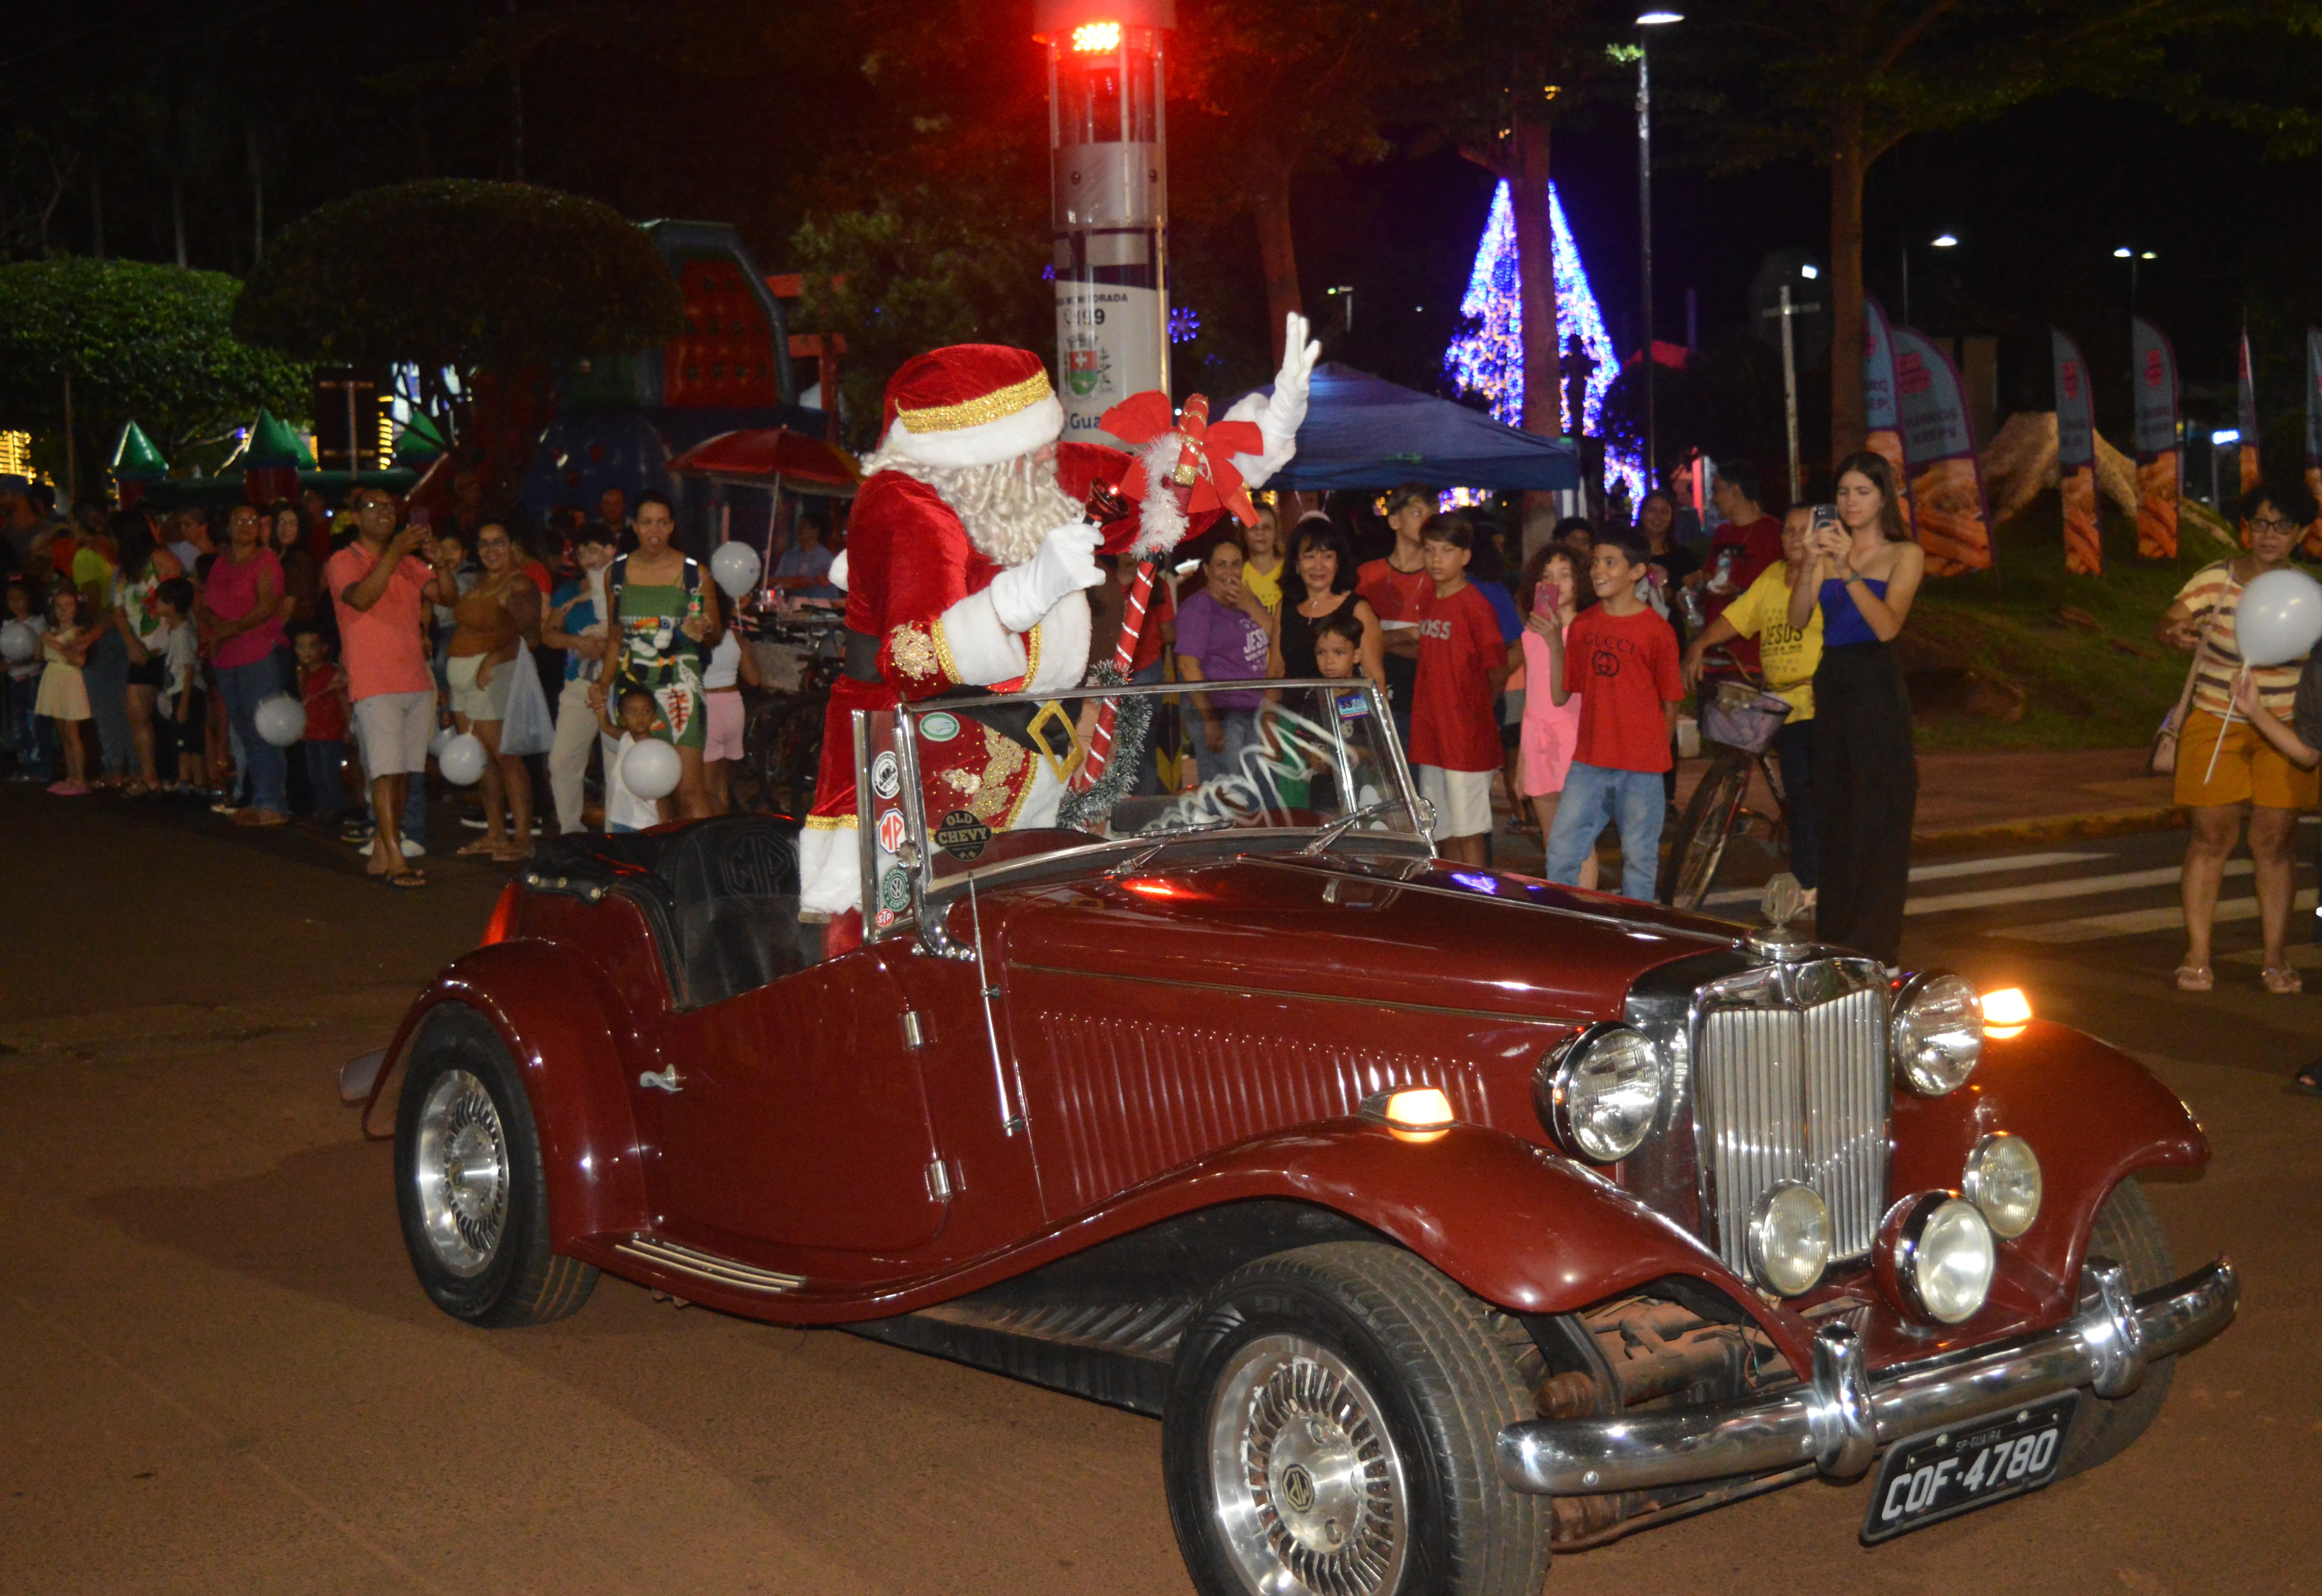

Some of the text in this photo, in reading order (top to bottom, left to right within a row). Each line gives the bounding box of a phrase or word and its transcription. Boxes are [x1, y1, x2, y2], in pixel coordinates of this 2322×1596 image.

[1419, 618, 1452, 640] OSS
[945, 813, 973, 826] OLD
[882, 815, 903, 850] MP
[938, 827, 987, 844] CHEVY
[889, 893, 910, 908] COFFEE
[878, 911, 892, 924] STP
